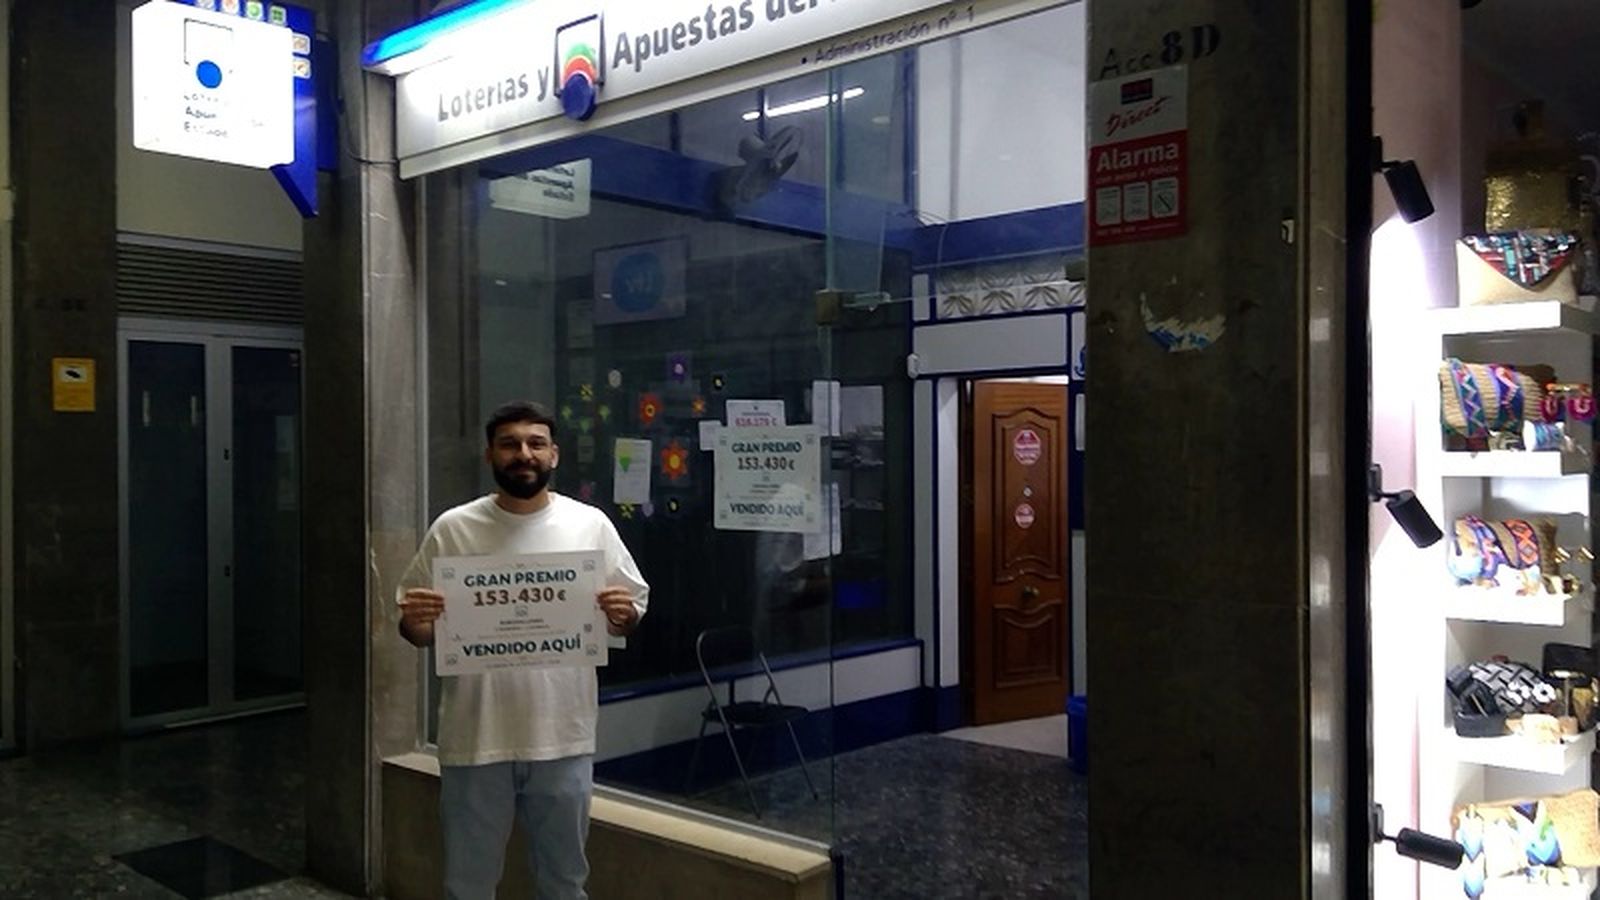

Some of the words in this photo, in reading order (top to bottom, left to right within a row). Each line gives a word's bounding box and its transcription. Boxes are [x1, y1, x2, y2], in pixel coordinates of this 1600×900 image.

[814, 21, 930, 65] Administración
[966, 4, 975, 22] 1
[537, 65, 549, 102] y
[612, 0, 755, 73] Apuestas
[1106, 94, 1173, 138] Direct
[1095, 142, 1180, 174] Alarma
[731, 442, 760, 453] GRAN
[762, 440, 802, 453] PREMIO
[729, 502, 775, 515] VENDIDO
[463, 573, 511, 588] GRAN
[515, 569, 577, 584] PREMIO
[462, 640, 537, 657] VENDIDO
[540, 634, 581, 653] AQUÍ
